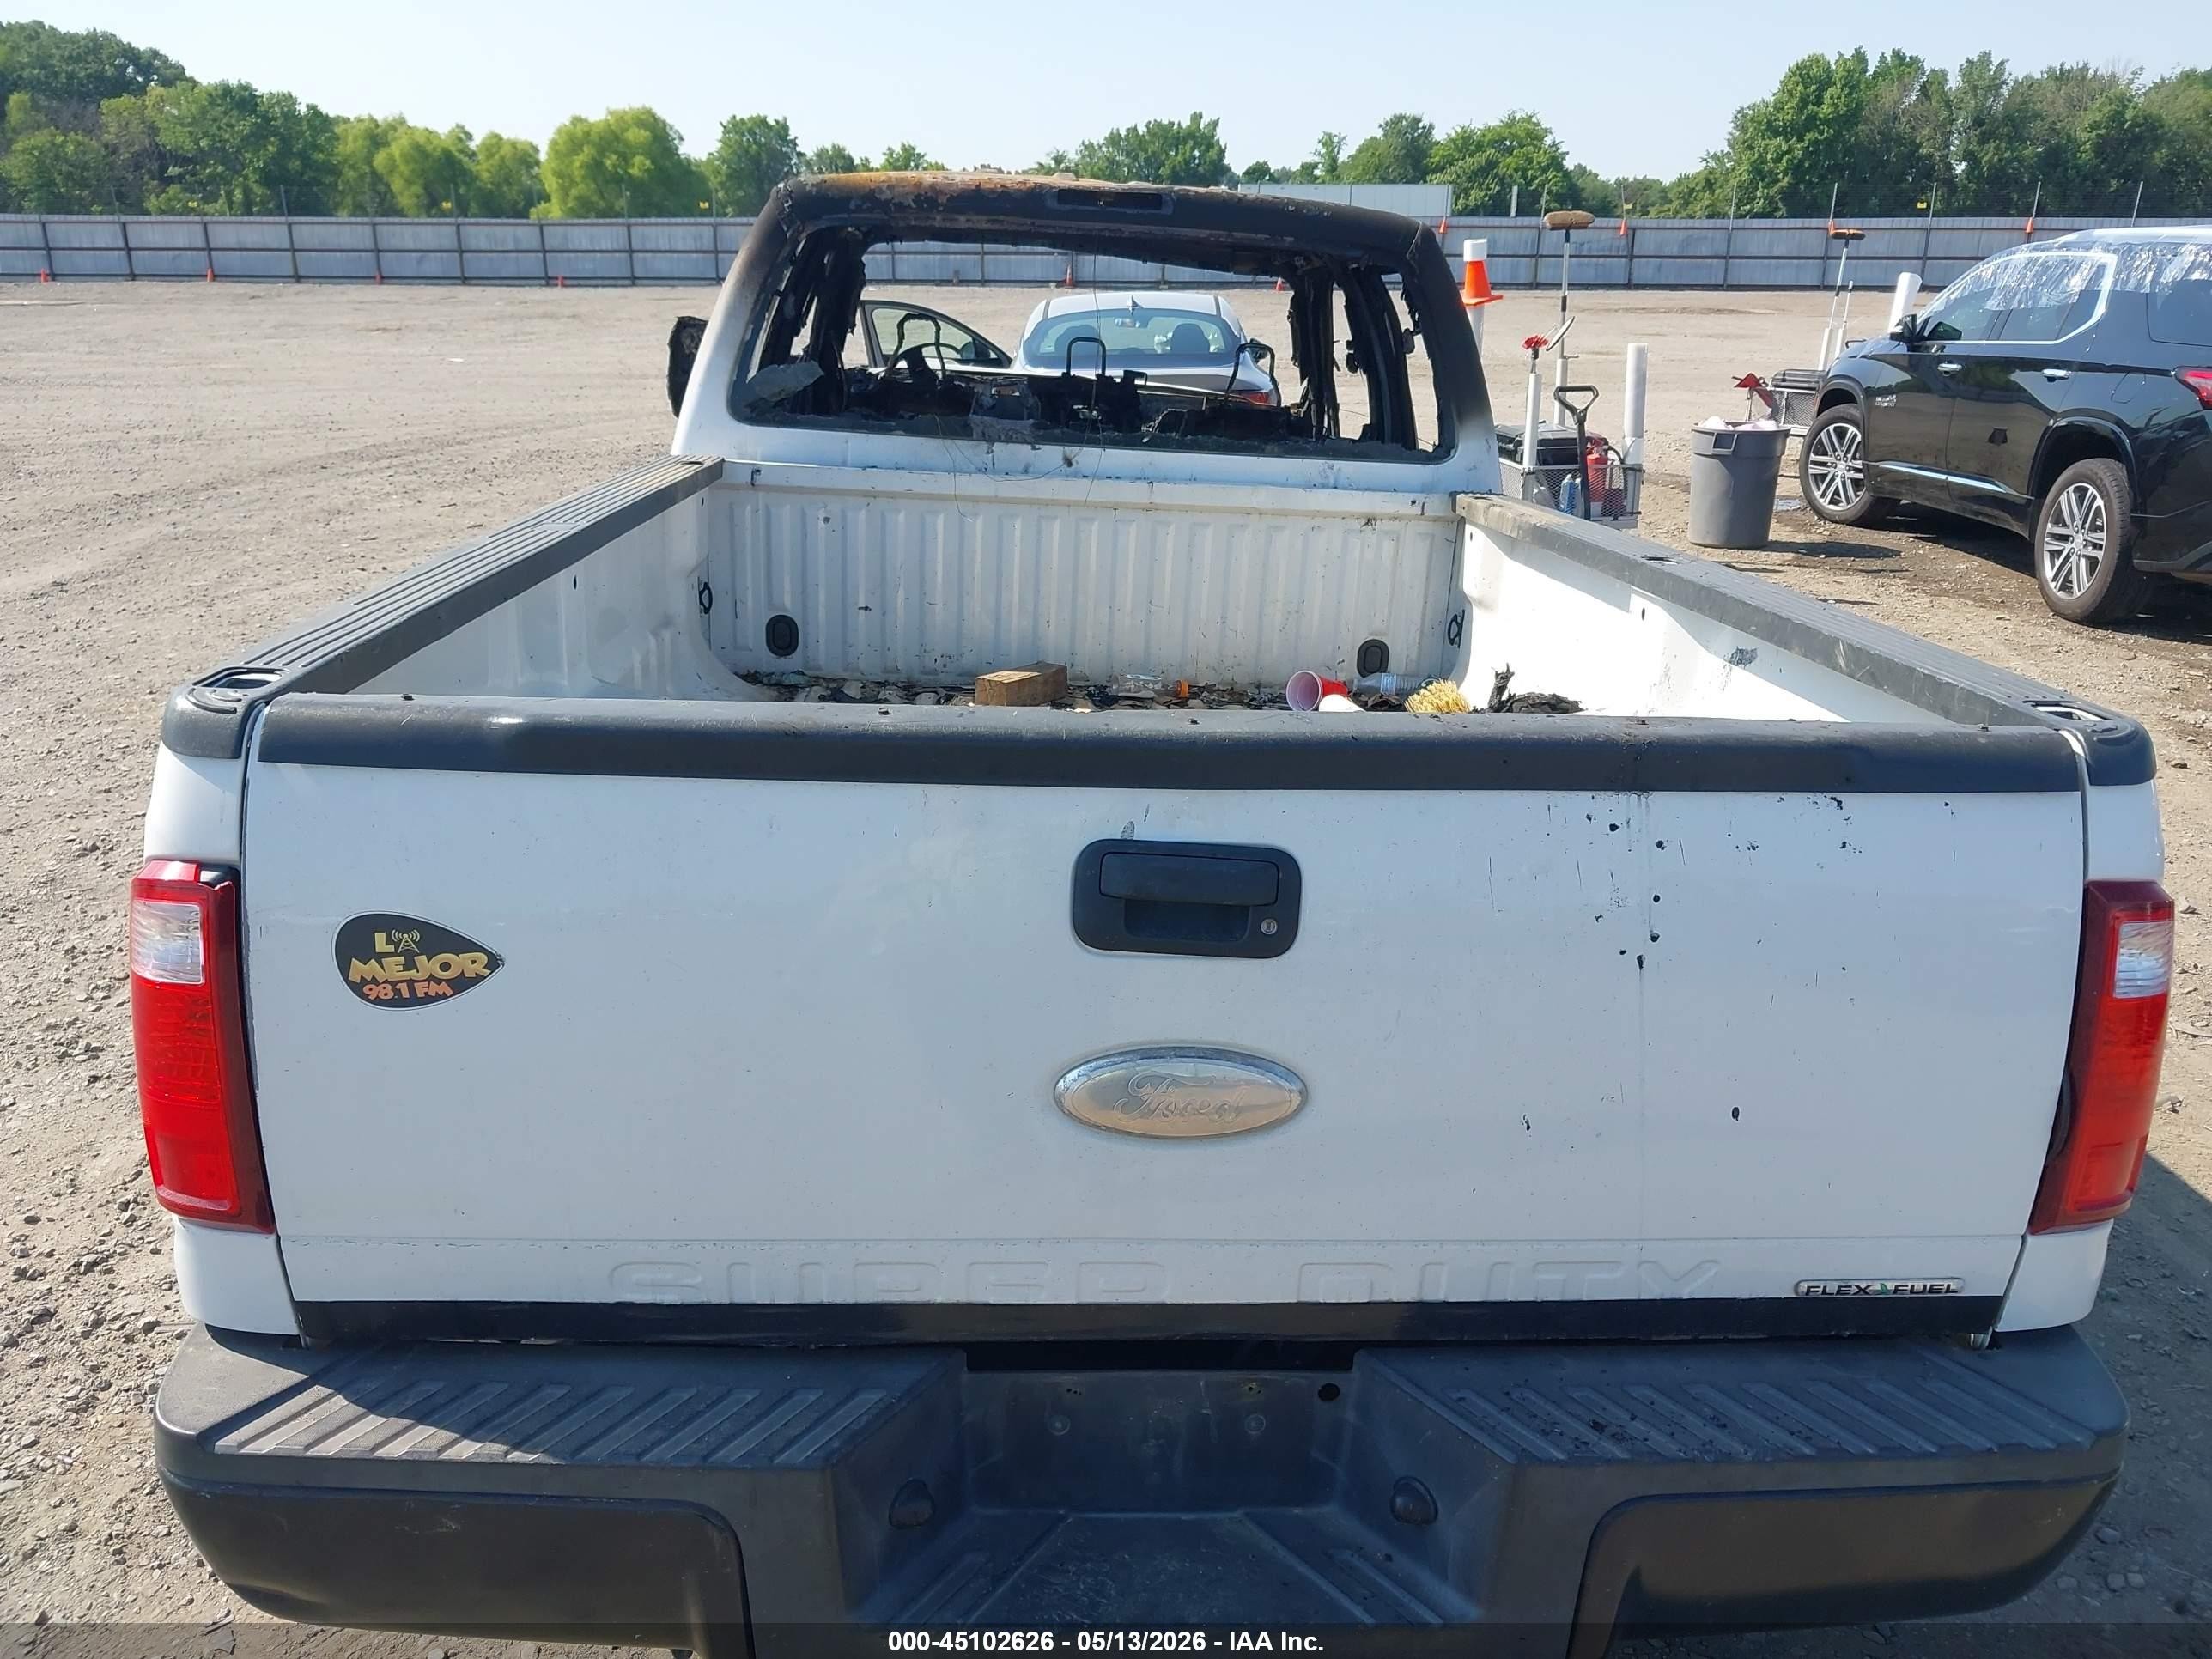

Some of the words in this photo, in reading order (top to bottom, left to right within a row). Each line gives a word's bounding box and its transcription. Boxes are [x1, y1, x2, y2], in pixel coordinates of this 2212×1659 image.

[348, 951, 492, 984] MEJOR
[362, 982, 410, 1000] 98.1
[414, 981, 454, 998] FM
[1113, 1070, 1246, 1122] Ford
[1805, 1285, 1873, 1296] FLEX
[1892, 1284, 1960, 1294] FUEL
